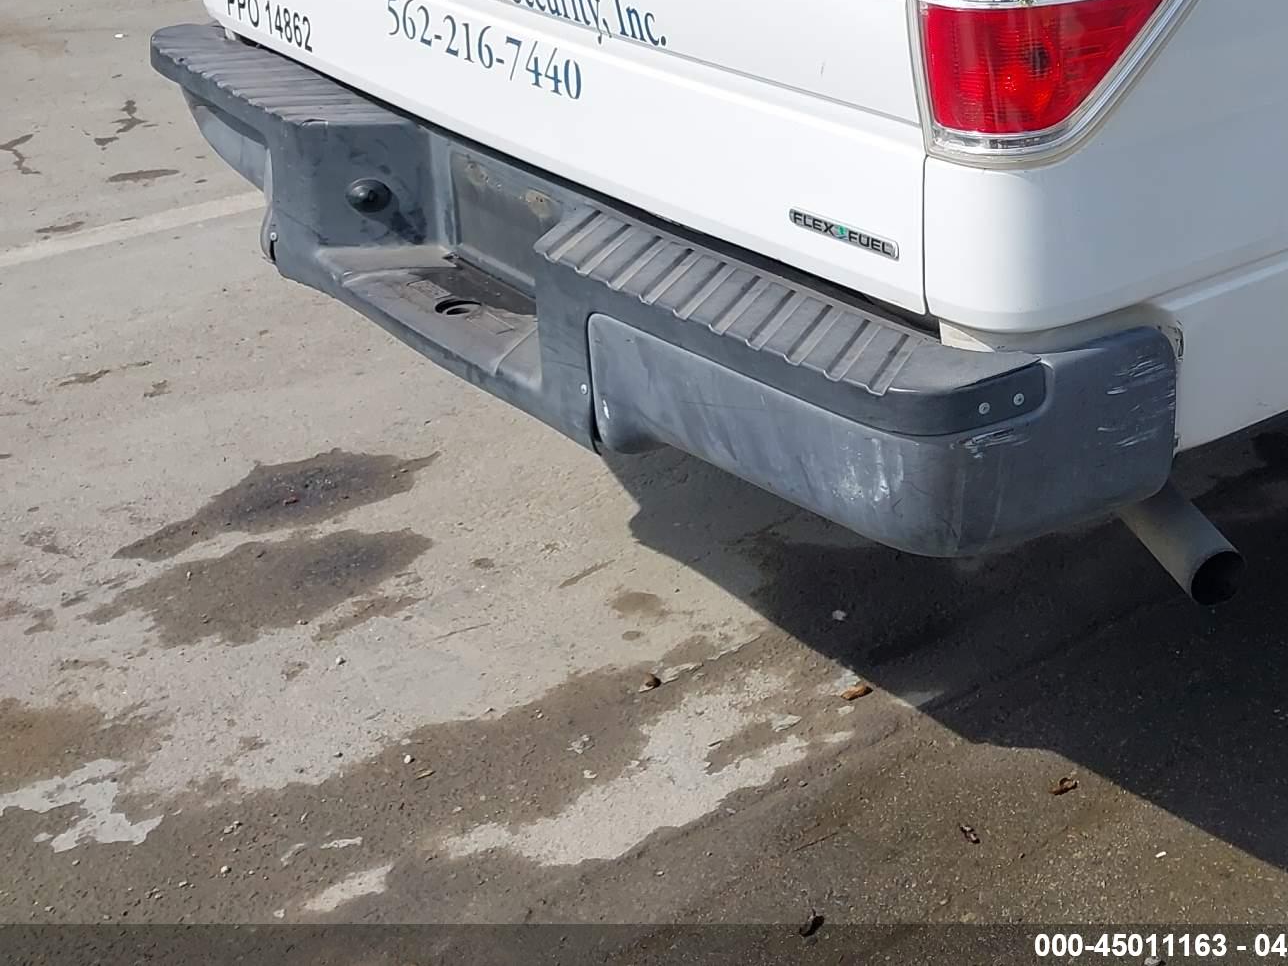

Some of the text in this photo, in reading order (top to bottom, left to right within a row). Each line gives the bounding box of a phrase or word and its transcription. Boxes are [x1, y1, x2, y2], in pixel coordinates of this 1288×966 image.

[265, 0, 313, 53] 14862
[793, 211, 893, 256] FLEX FUEL
